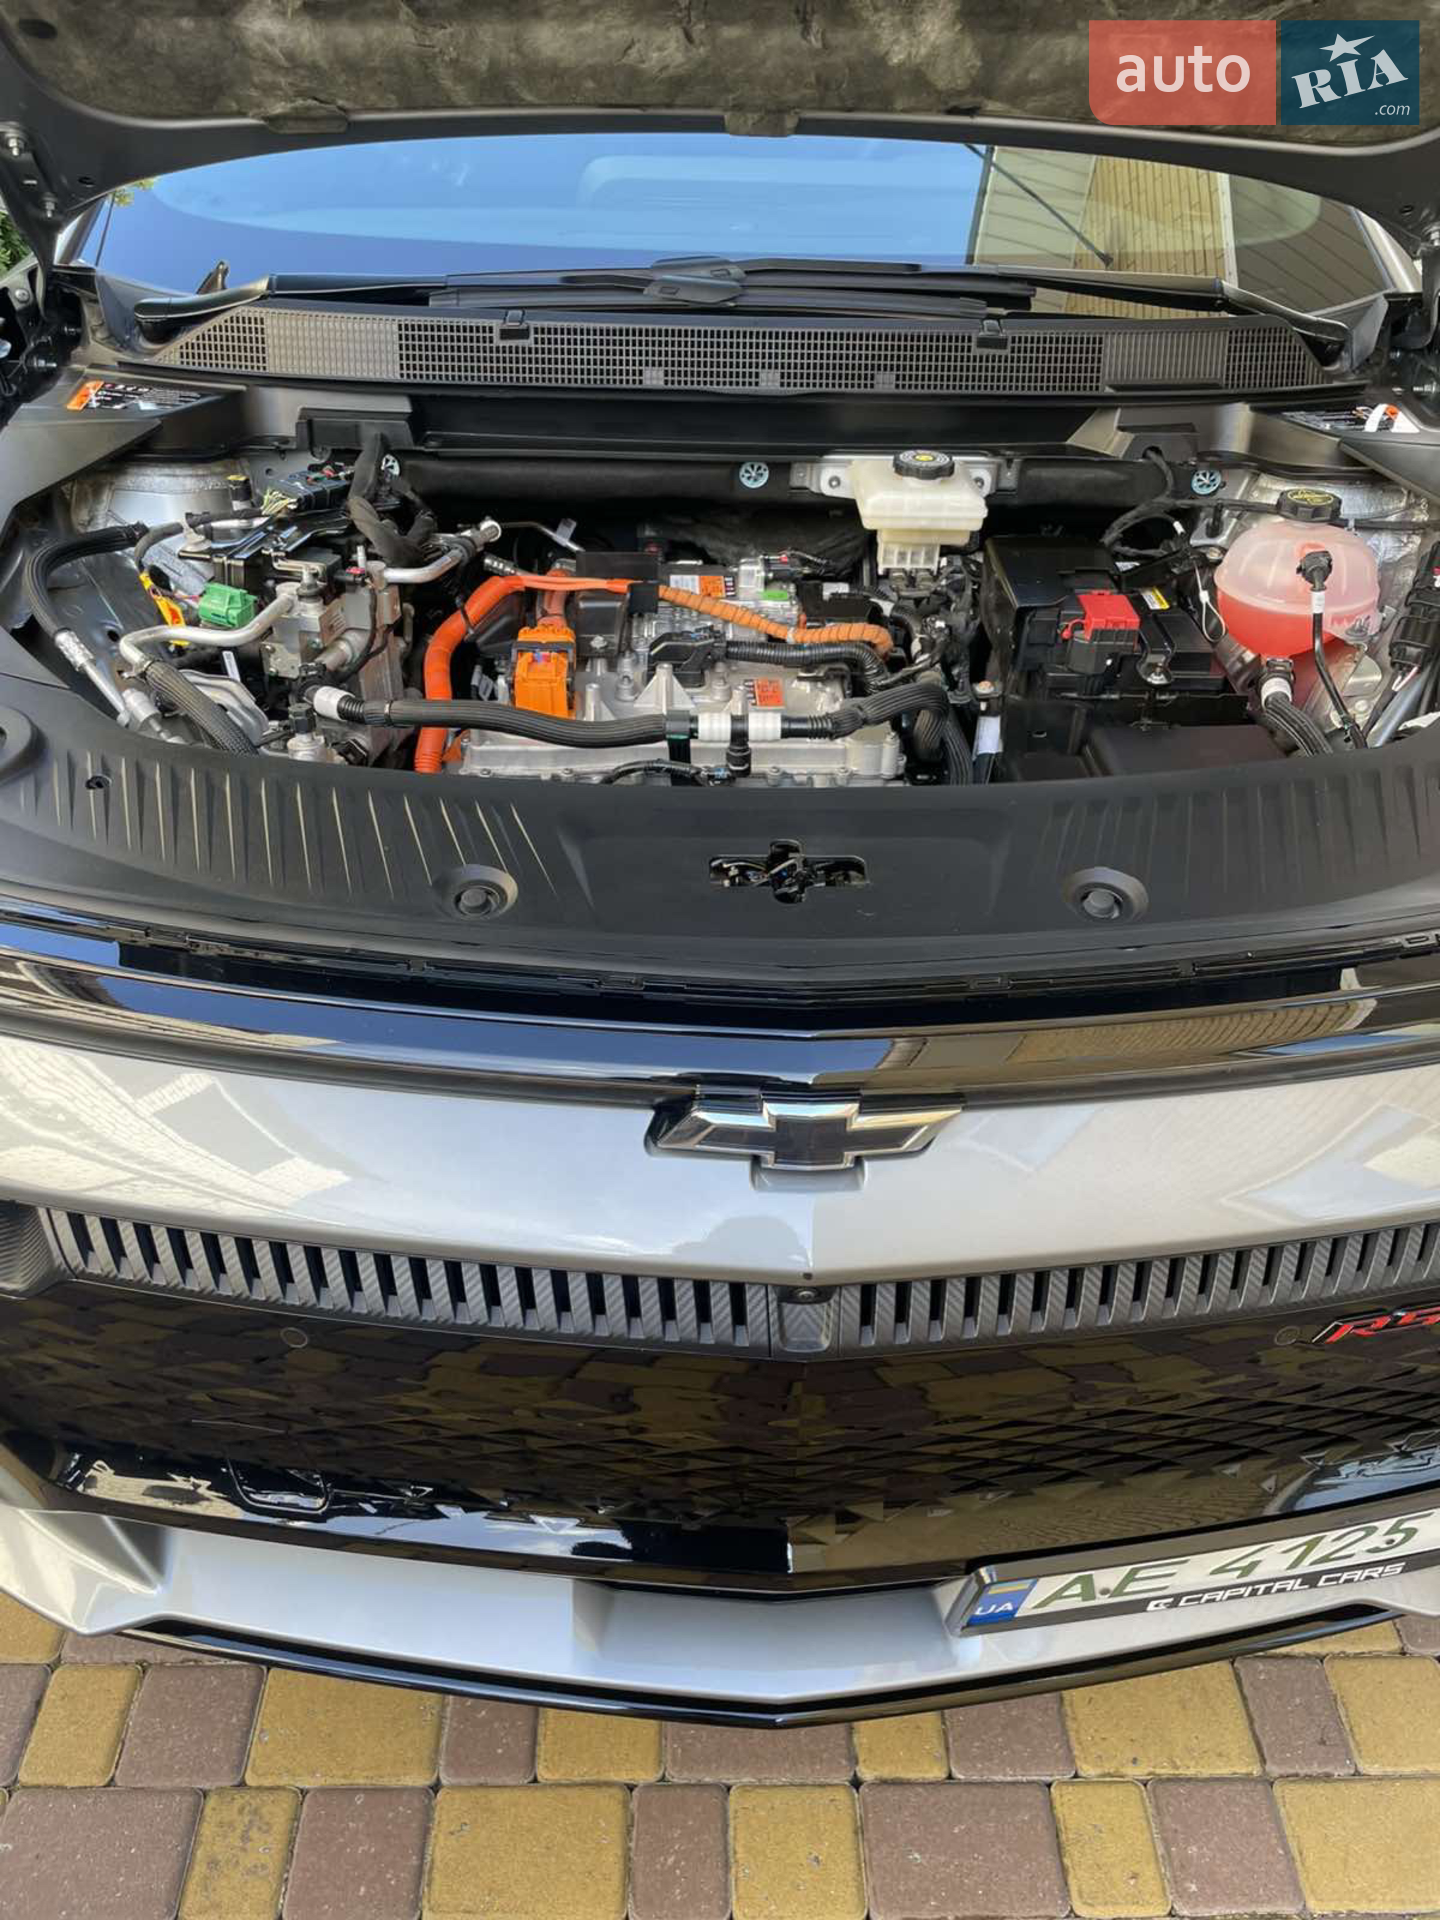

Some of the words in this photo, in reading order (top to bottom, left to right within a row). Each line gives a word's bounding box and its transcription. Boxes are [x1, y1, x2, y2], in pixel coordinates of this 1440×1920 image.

[1031, 1559, 1190, 1609] AE
[1208, 1511, 1435, 1579] 4125
[1178, 1577, 1310, 1607] CAPITAL
[1317, 1562, 1407, 1588] CARS
[975, 1603, 1013, 1616] UA
